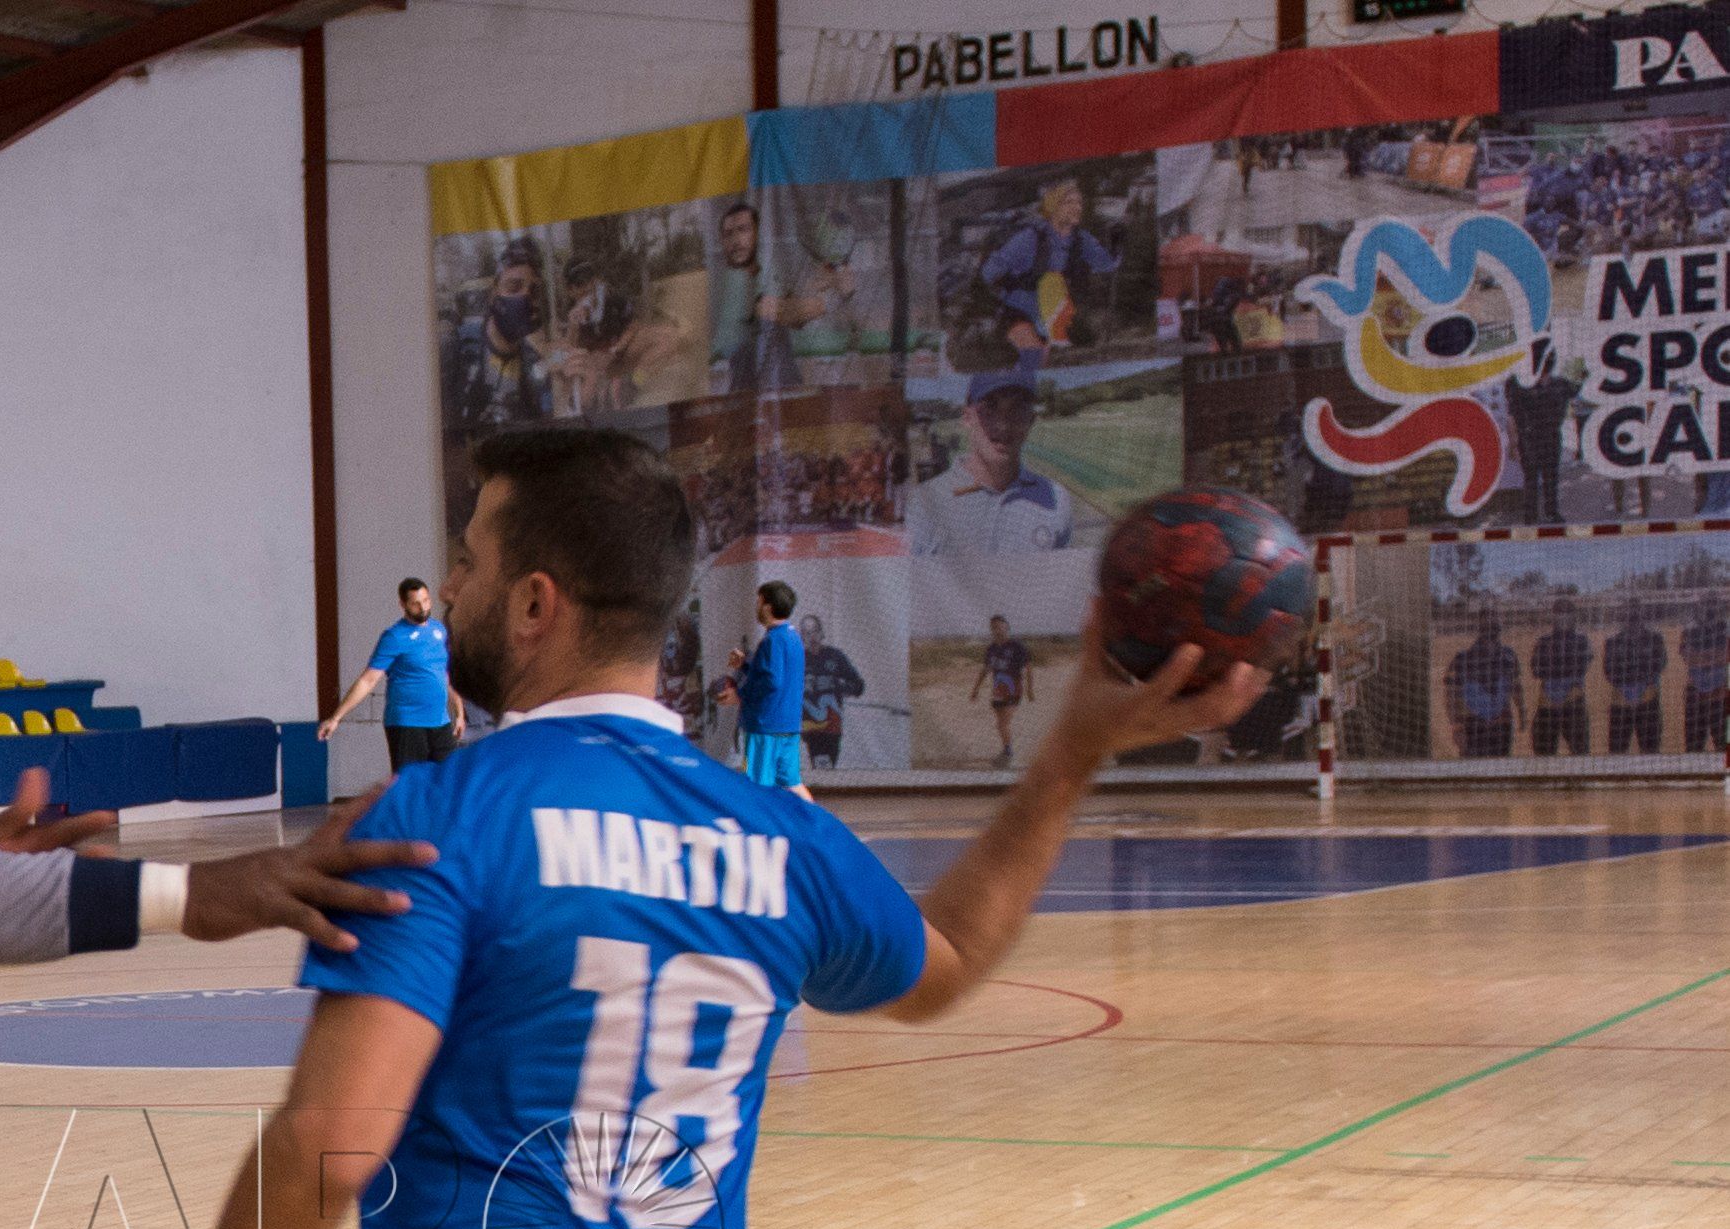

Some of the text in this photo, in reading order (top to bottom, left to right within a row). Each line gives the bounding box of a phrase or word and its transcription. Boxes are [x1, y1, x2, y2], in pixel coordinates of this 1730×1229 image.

[891, 15, 1158, 93] PABELLON
[1598, 252, 1730, 321] ME
[1597, 400, 1730, 467] CA
